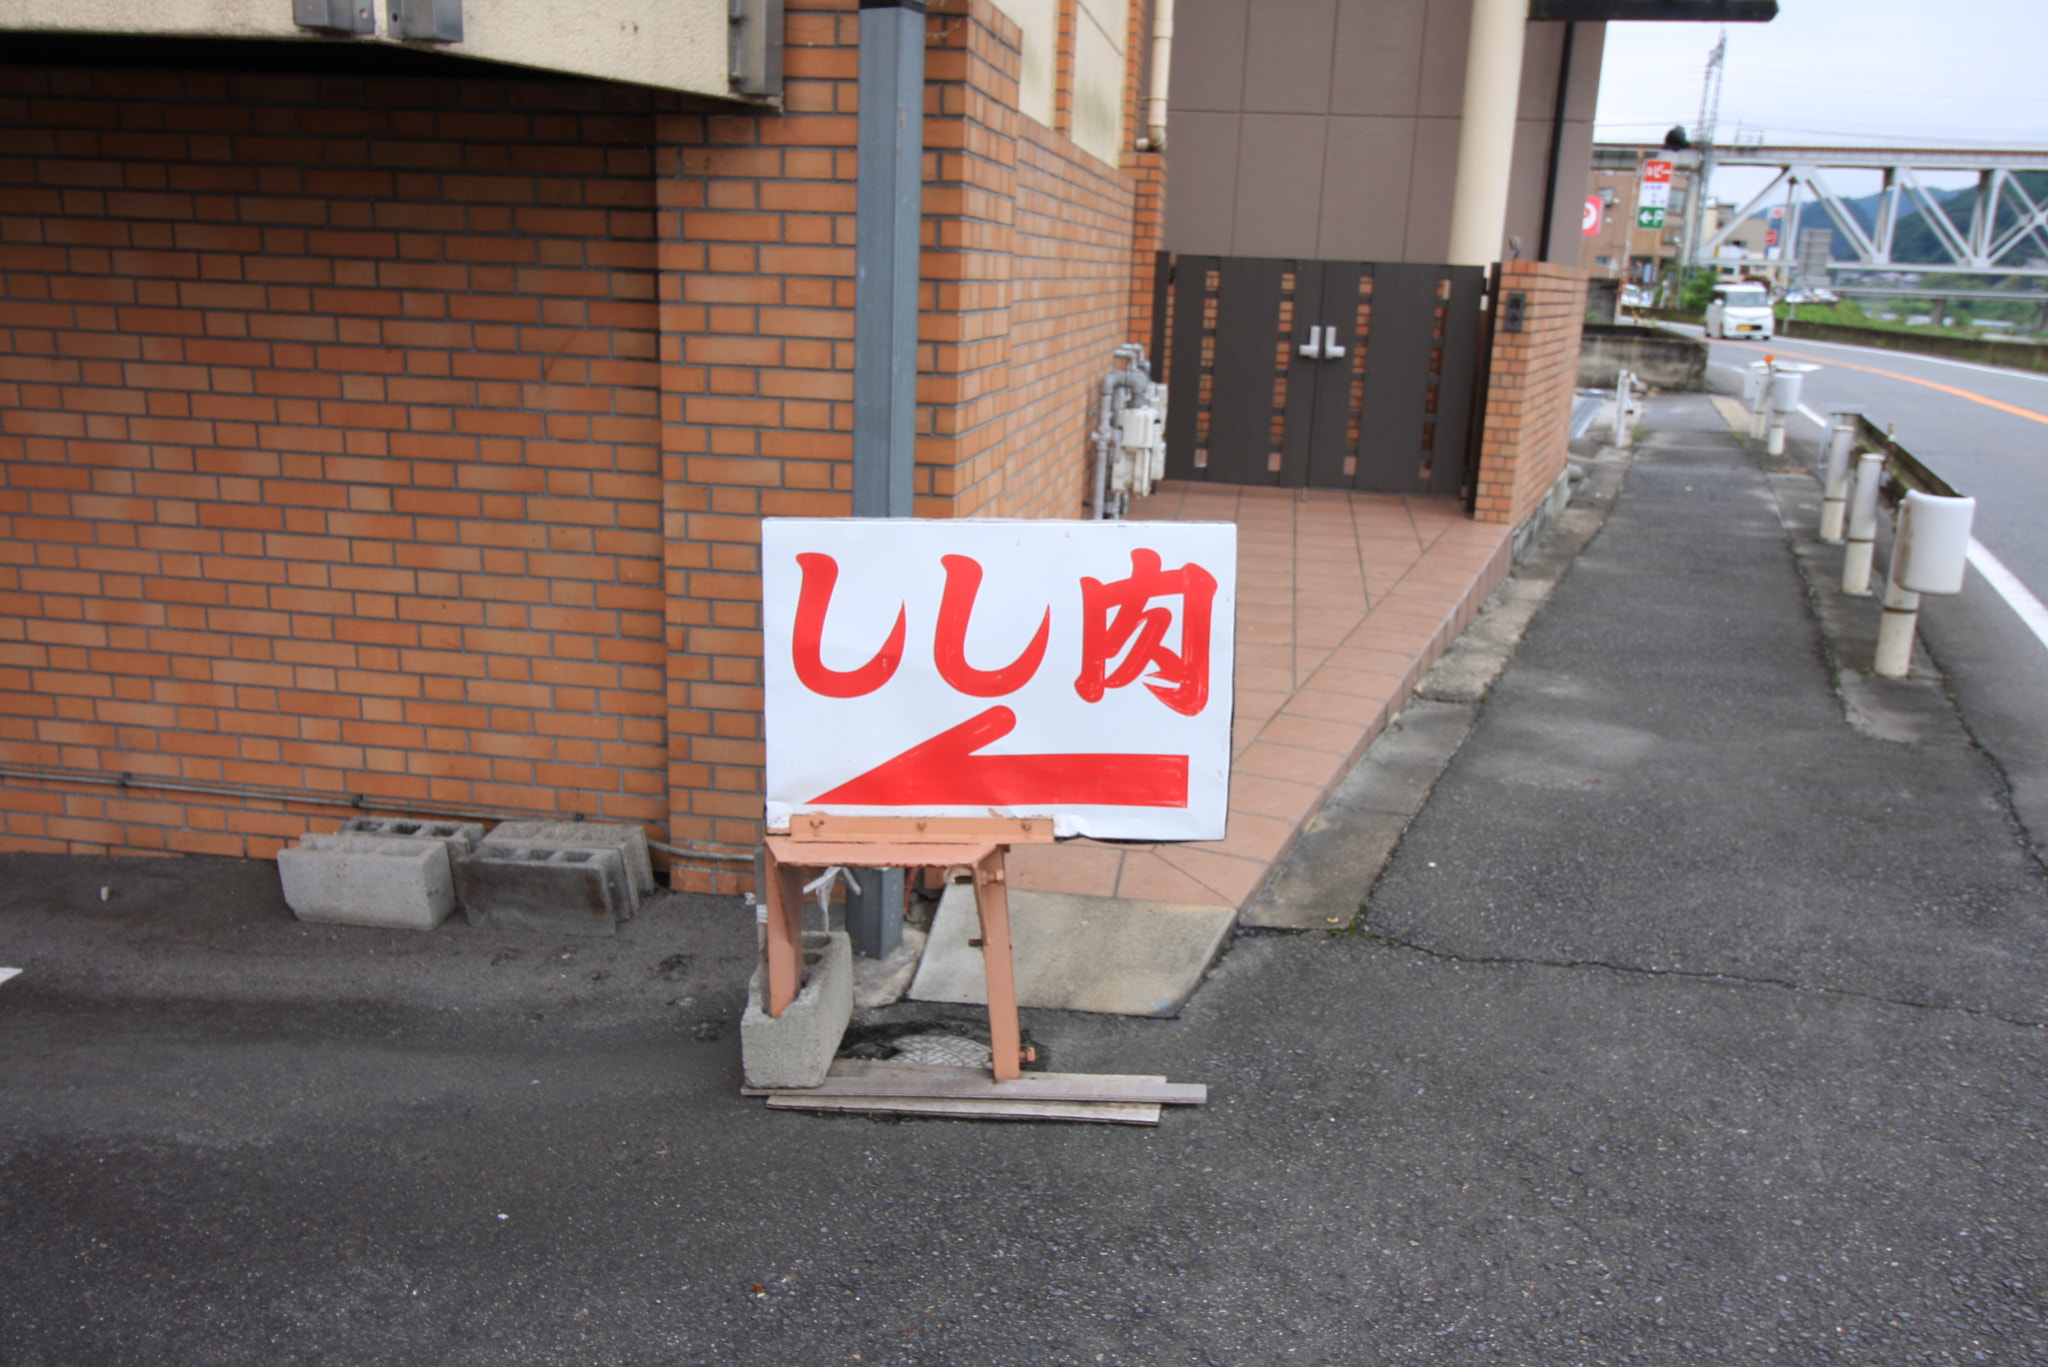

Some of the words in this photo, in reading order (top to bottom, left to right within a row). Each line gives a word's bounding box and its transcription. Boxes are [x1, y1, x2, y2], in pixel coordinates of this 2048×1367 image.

[1653, 210, 1664, 225] P
[791, 547, 1219, 717] しし肉
